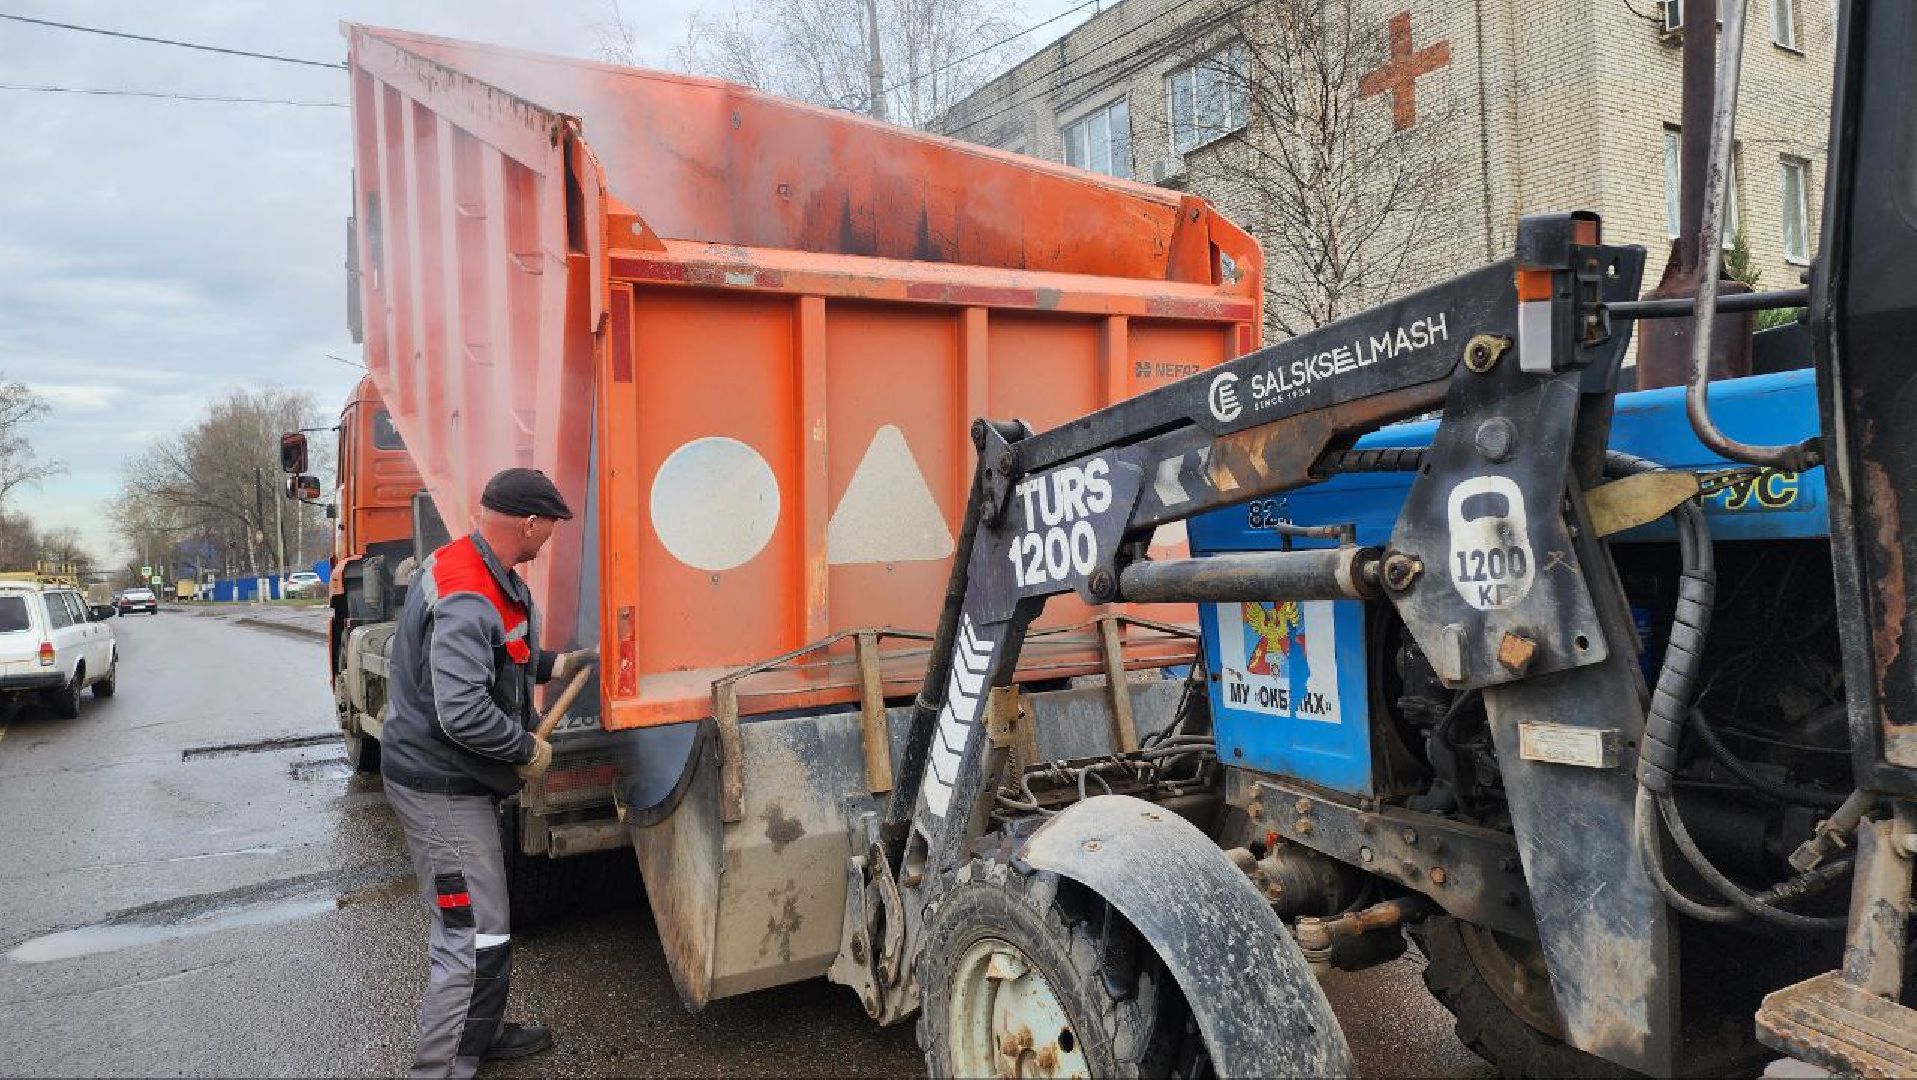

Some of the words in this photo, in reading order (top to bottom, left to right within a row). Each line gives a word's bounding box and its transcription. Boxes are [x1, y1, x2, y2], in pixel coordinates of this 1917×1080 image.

[1251, 312, 1449, 399] SALSKSELMASH
[1254, 395, 1284, 411] SINCE
[1015, 457, 1113, 532] TURS
[1008, 520, 1098, 588] 1200
[1456, 546, 1527, 583] 1200
[1230, 682, 1250, 704] МУ
